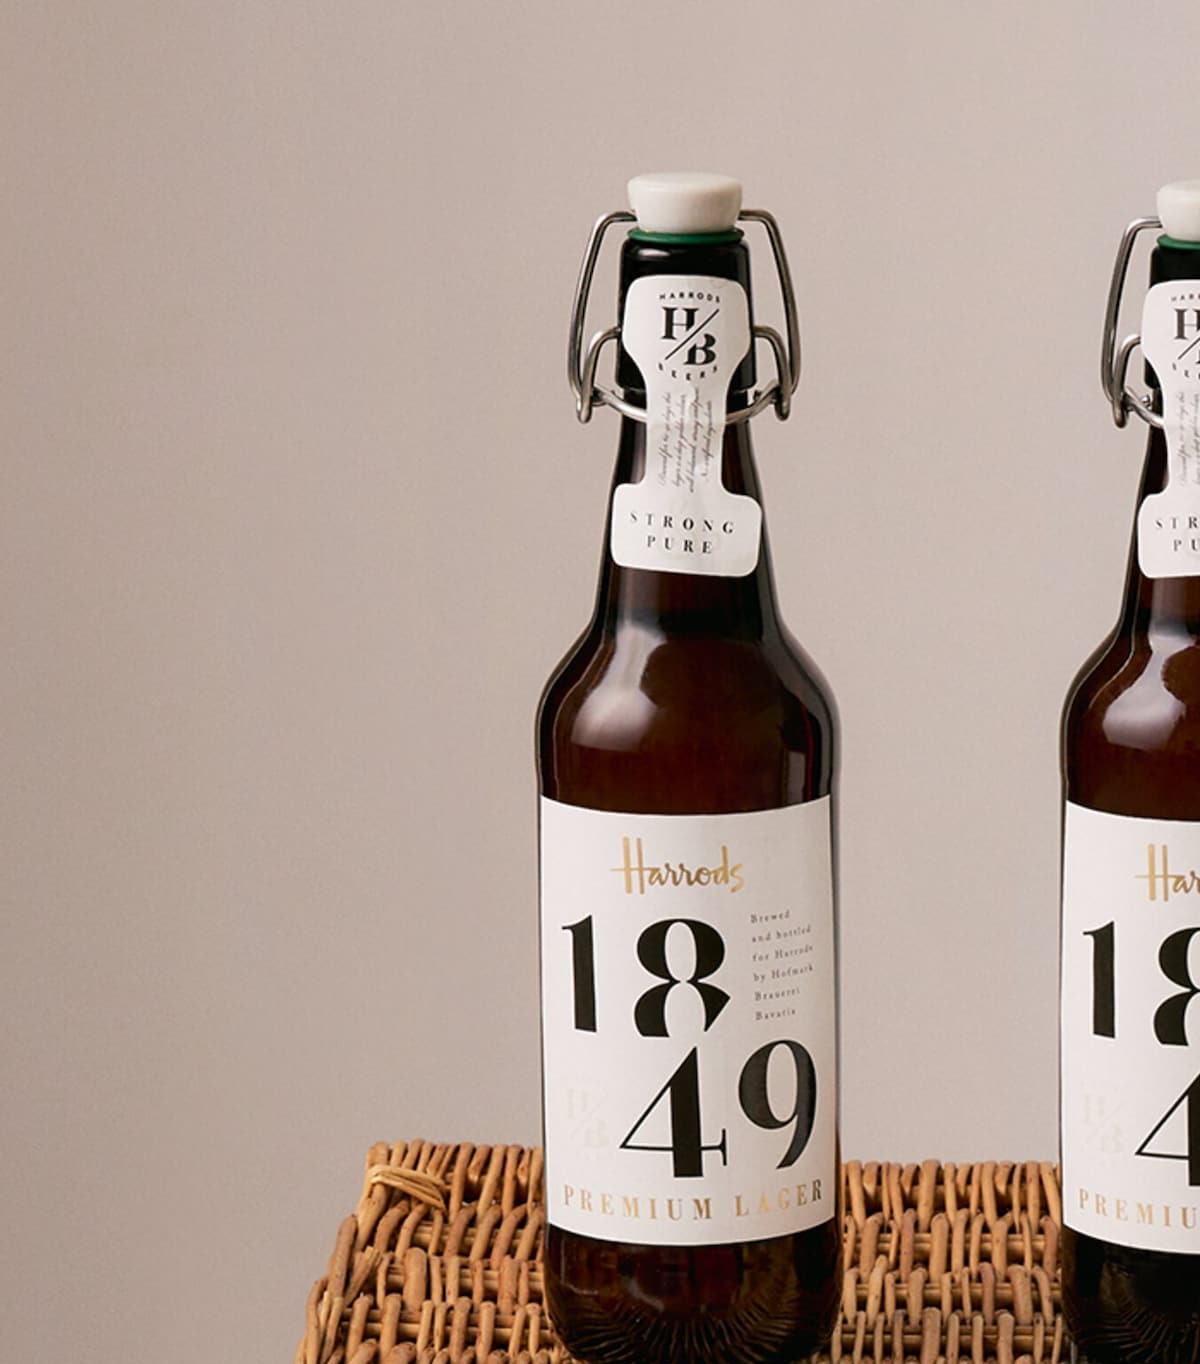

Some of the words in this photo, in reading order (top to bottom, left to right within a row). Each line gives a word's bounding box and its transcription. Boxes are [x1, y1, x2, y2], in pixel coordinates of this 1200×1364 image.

[629, 511, 735, 535] STRONG
[647, 536, 712, 555] PURE
[610, 836, 745, 894] Harrods
[750, 909, 790, 924] Brewed
[752, 932, 771, 942] and
[776, 924, 811, 940] bottled
[752, 953, 769, 962] for
[775, 944, 813, 959] Harrods
[561, 914, 731, 1038] 18
[753, 973, 765, 983] by
[618, 1039, 817, 1179] 49
[563, 1184, 712, 1221] PREMIUM
[734, 1179, 822, 1217] LAGER
